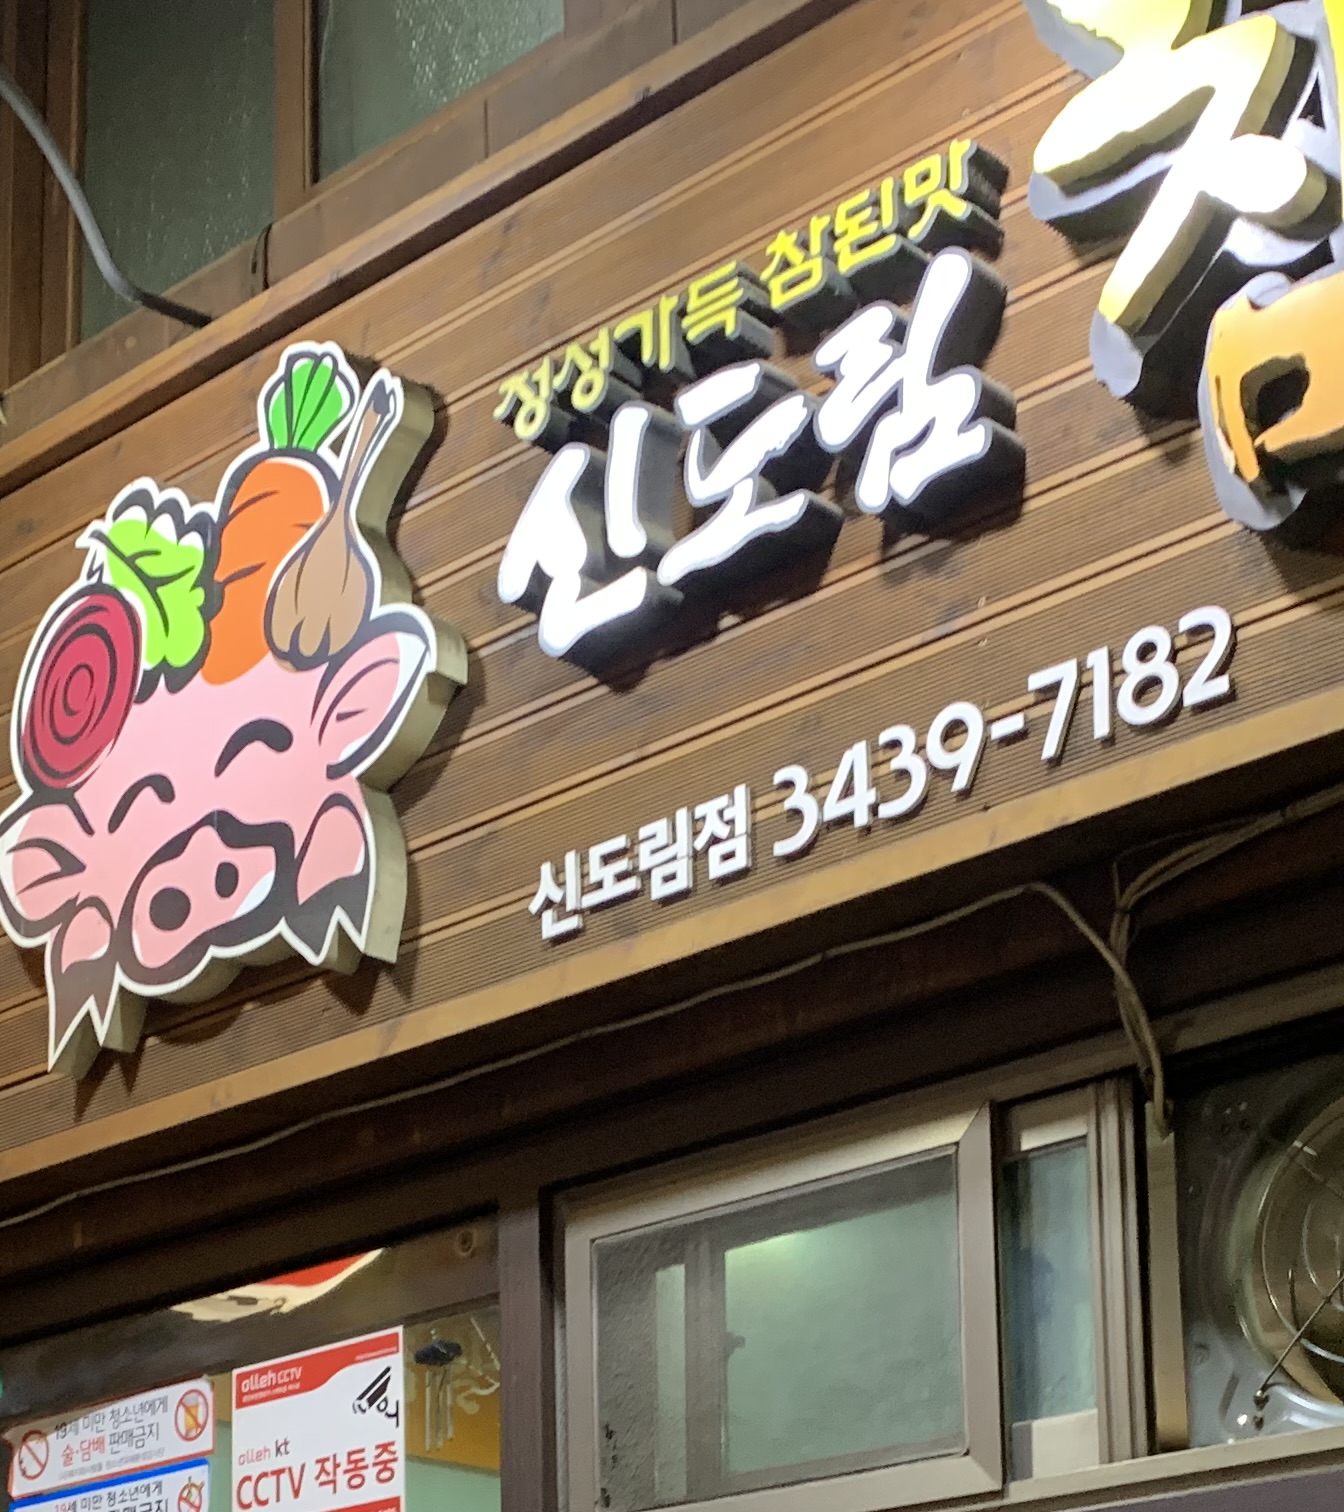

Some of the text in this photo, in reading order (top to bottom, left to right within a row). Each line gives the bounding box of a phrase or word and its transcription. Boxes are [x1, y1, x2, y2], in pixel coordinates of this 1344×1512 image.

[493, 139, 976, 441] 정성가득 참된맛
[497, 246, 992, 656] 신도림
[527, 605, 1239, 938] 신도림점 3439-7182
[82, 1411, 106, 1433] 미만
[108, 1395, 169, 1430] 청소년에게
[108, 1422, 160, 1456] 판매금지
[236, 1440, 399, 1510] CCTV 작동중
[238, 1437, 290, 1466] olleh kt
[80, 1494, 103, 1511] 미만
[106, 1480, 164, 1506] 청소년에게
